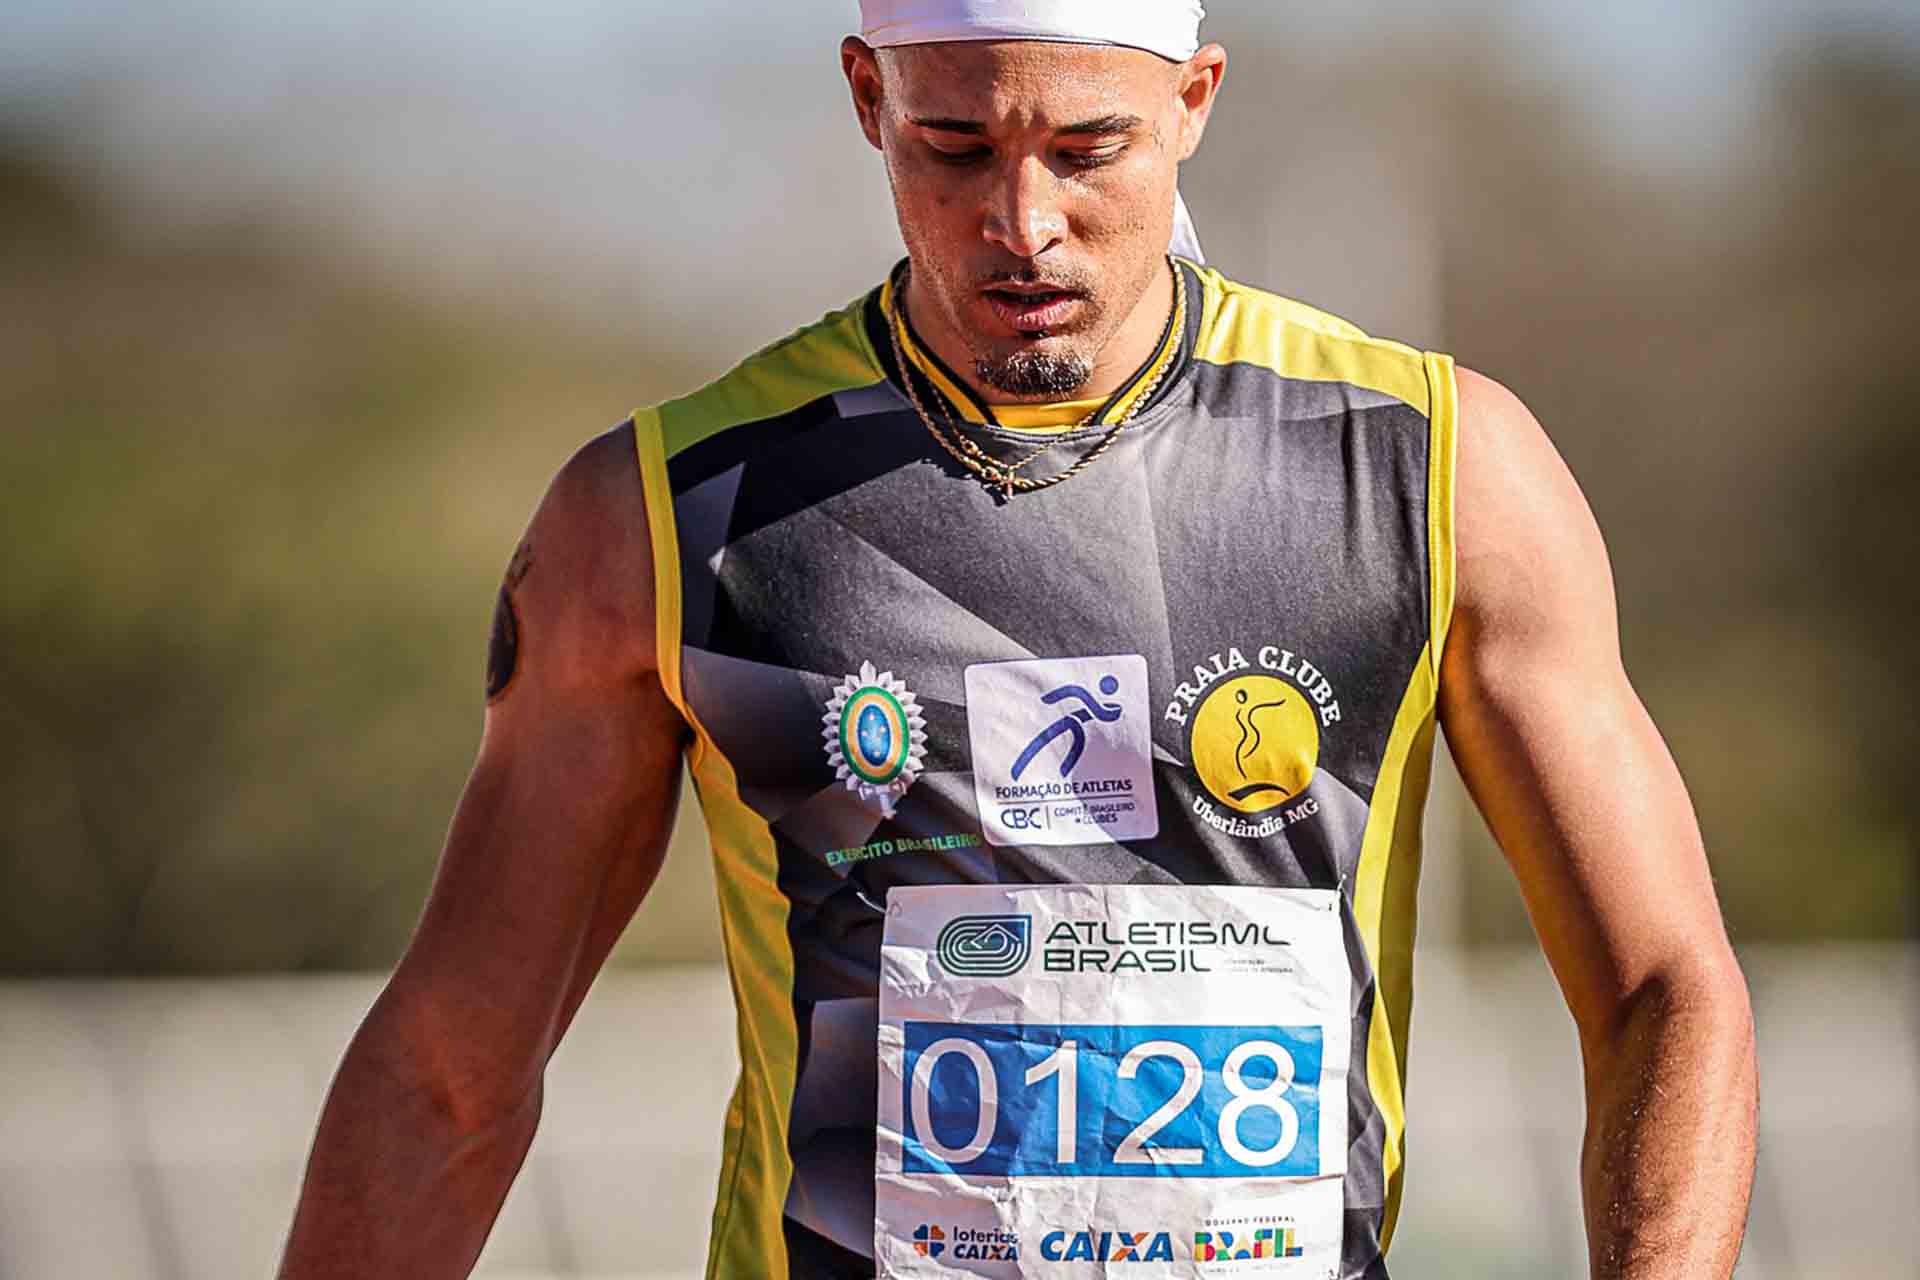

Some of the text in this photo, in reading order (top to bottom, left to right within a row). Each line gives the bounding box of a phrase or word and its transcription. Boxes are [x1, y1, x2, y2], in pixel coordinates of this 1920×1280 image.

[1165, 646, 1341, 727] PRAIA CLUBE
[995, 779, 1133, 799] FORMAÇÃO DE ATLETAS
[1000, 807, 1042, 829] CBC
[1192, 796, 1319, 838] Uberlândia MG
[1044, 949, 1212, 973] BRASIL
[911, 1037, 1299, 1168] 0128
[953, 1226, 1018, 1243] loterias
[1040, 1231, 1174, 1262] CAIXA
[1194, 1228, 1303, 1261] BRASIL
[953, 1244, 1018, 1261] CAIXA
